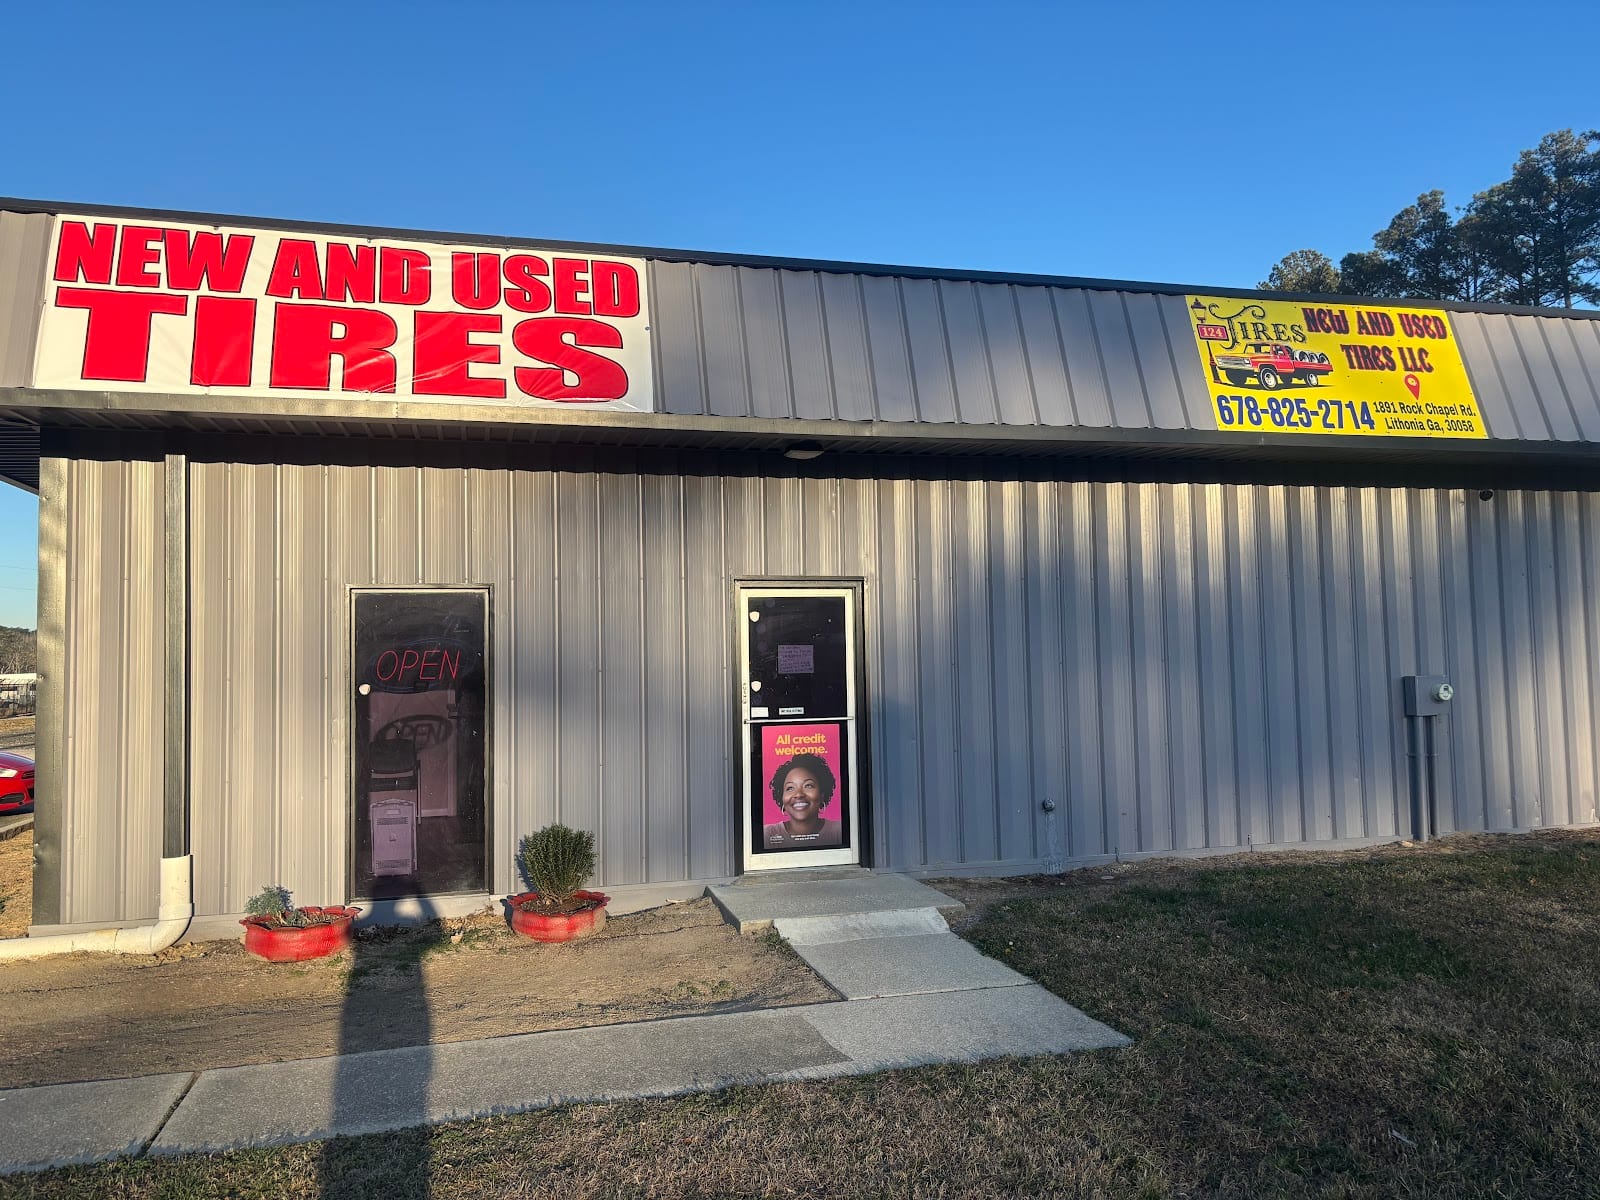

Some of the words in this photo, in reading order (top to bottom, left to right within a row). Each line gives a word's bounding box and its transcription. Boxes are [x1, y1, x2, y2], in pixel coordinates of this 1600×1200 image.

[54, 220, 254, 293] NEW
[265, 238, 432, 307] AND
[450, 252, 641, 318] USED
[1201, 326, 1225, 339] 124
[1300, 307, 1350, 335] NEW
[1356, 311, 1395, 337] AND
[1397, 313, 1448, 340] USED
[54, 287, 631, 403] TIRES
[1340, 343, 1397, 372] TIRES
[1398, 347, 1434, 374] LLC
[1216, 394, 1376, 430] 678-825-2714
[1373, 401, 1398, 414] 1891
[1398, 402, 1423, 415] Rock
[1425, 403, 1458, 417] Chapel
[1460, 404, 1477, 417] Rd.
[1384, 416, 1426, 431] Lithonia
[1426, 418, 1444, 433] Ga,
[1445, 419, 1475, 432] 30058
[376, 651, 460, 681] OPEN
[775, 745, 828, 755] welcome.
[776, 734, 791, 745] All
[792, 733, 827, 744] credit
